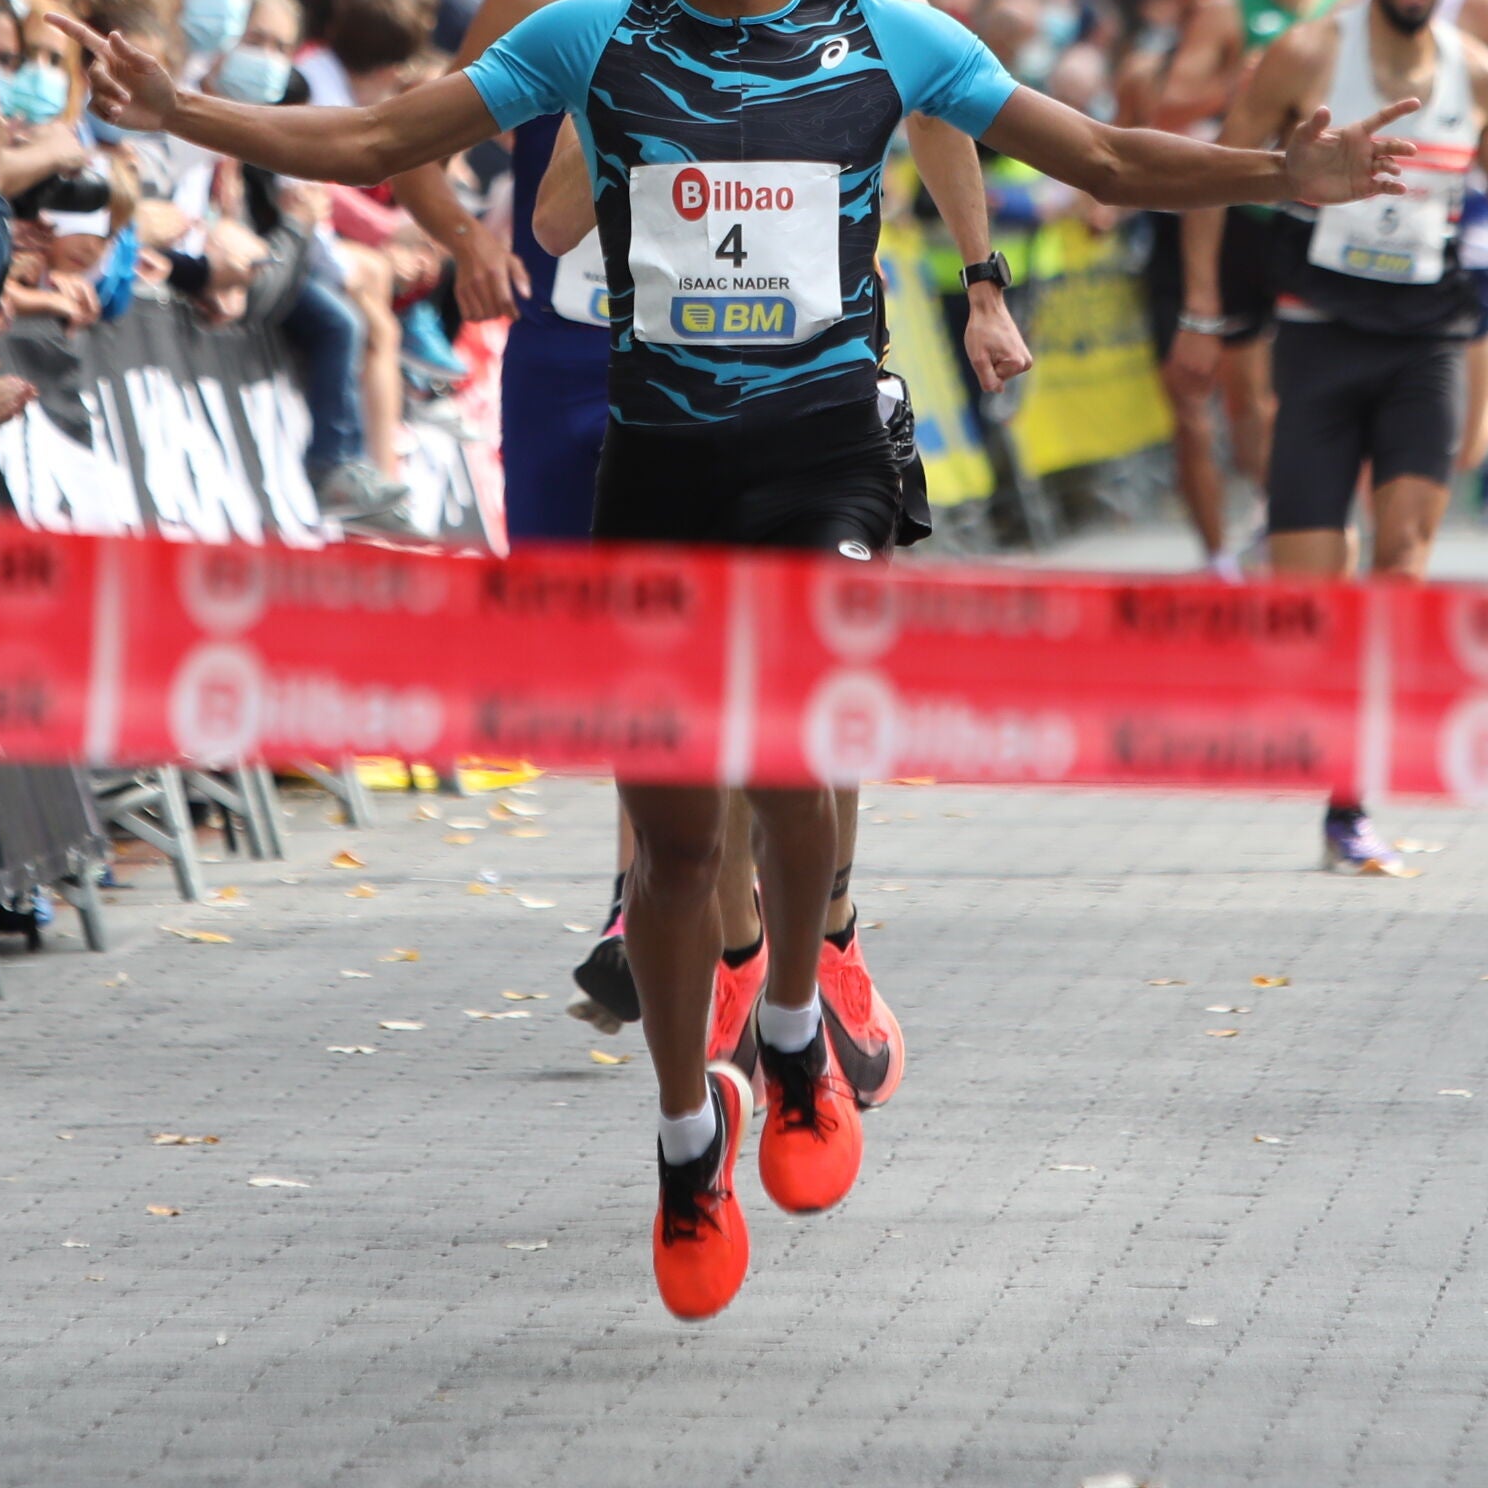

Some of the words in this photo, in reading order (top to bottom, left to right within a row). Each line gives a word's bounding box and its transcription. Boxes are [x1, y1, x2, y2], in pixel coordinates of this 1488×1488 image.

[672, 167, 794, 222] Bilbao
[715, 223, 748, 269] 4
[679, 277, 729, 291] ISAAC
[731, 276, 790, 291] NADER
[722, 302, 785, 334] BM
